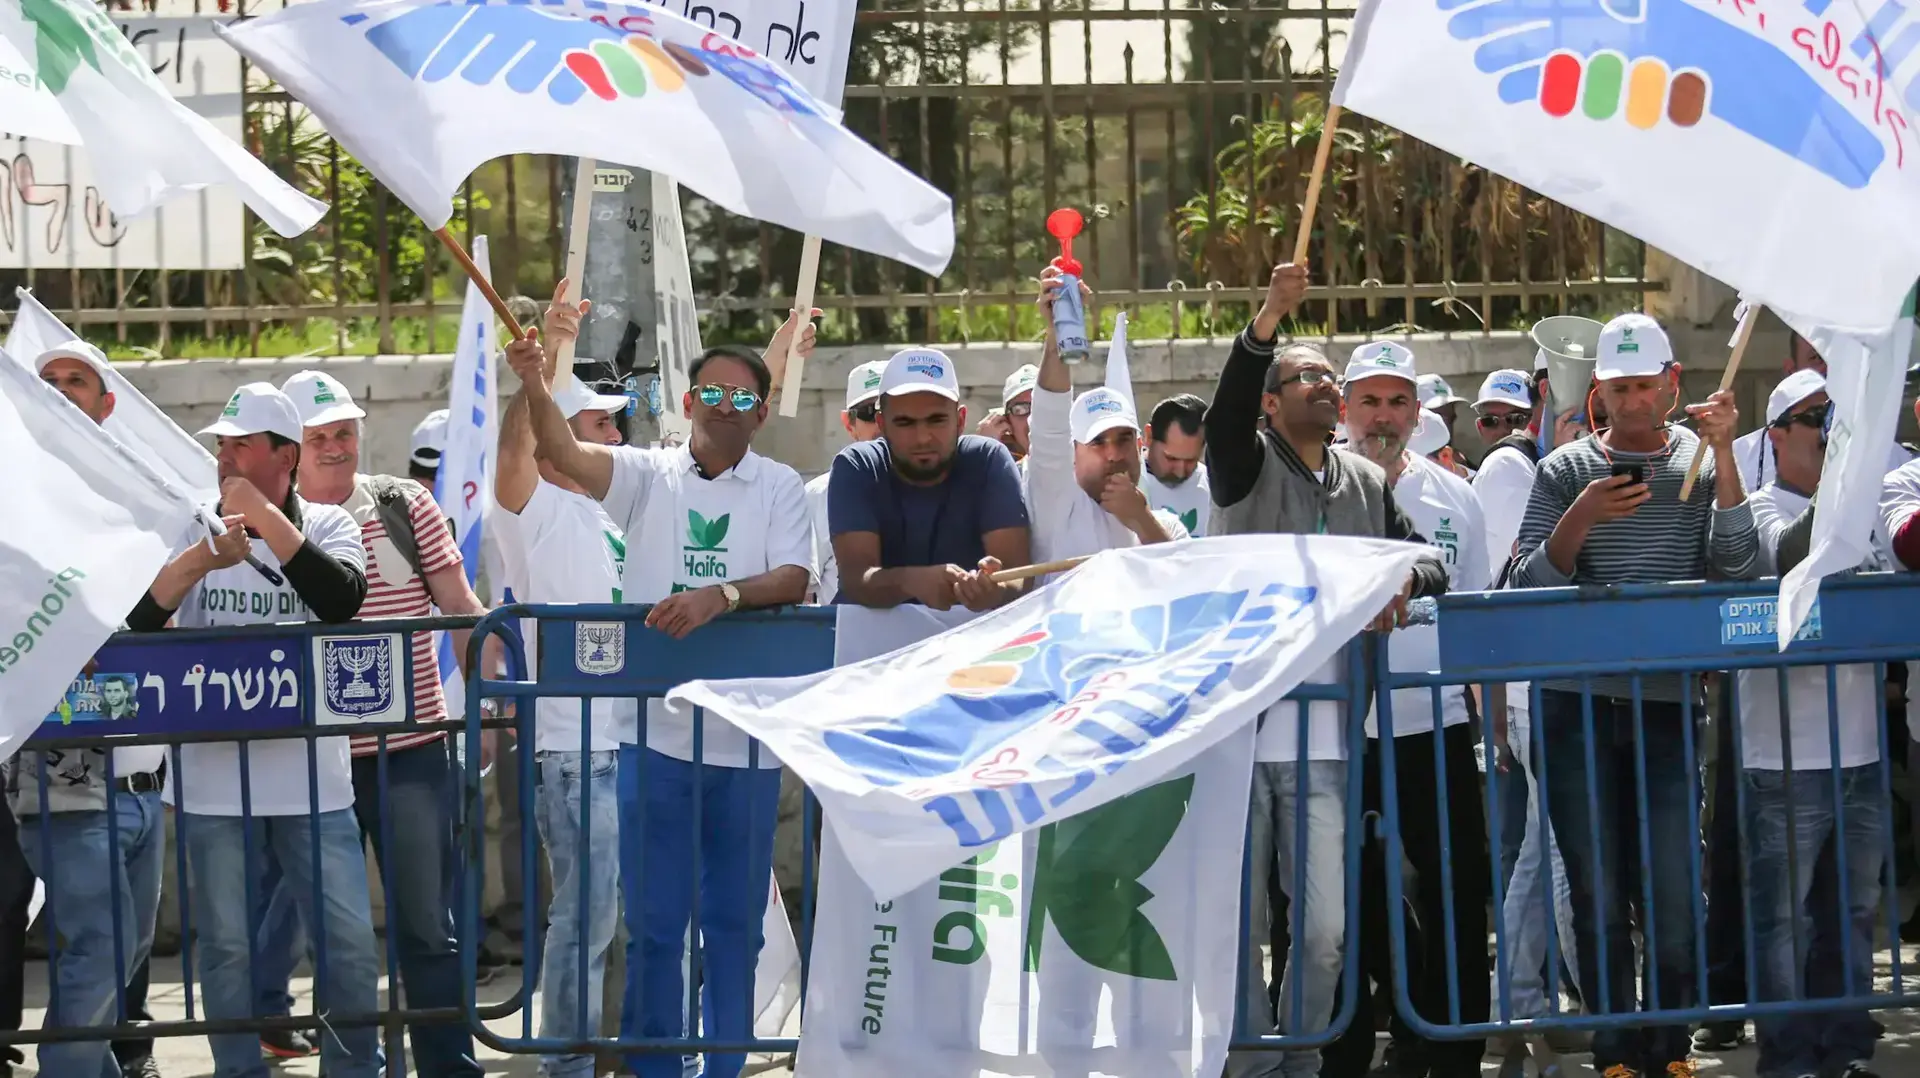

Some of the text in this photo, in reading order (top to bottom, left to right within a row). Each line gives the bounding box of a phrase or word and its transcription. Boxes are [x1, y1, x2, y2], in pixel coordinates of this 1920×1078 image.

[684, 554, 727, 578] Haifa
[251, 591, 273, 618] עם
[1727, 621, 1762, 640] אורון
[182, 665, 299, 713] משרד
[861, 924, 897, 1035] Future
